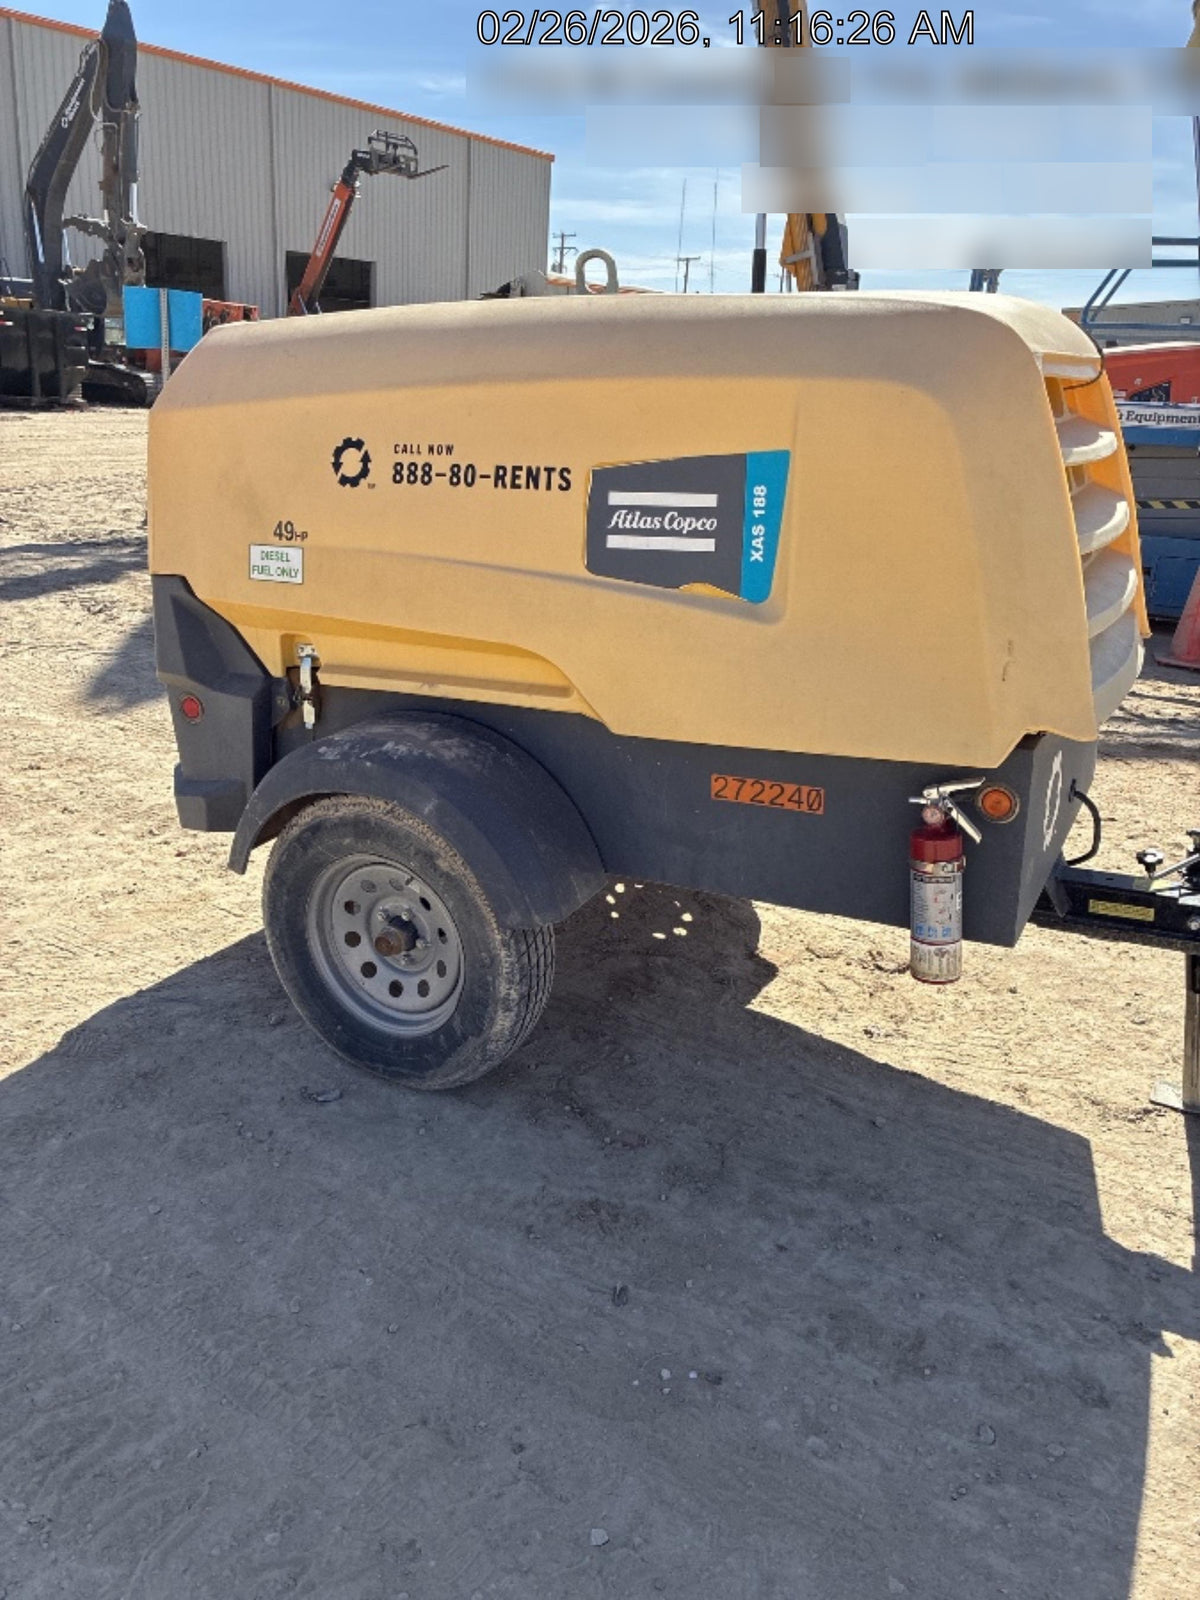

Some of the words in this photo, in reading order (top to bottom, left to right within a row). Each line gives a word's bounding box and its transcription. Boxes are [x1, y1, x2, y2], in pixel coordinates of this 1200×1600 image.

[394, 444, 421, 455] CALL
[428, 444, 454, 455] NOW
[392, 462, 572, 491] 888-80-RENTS
[752, 485, 768, 518] 188
[607, 510, 661, 529] Atlas
[663, 511, 718, 534] Copco
[260, 550, 291, 562] DIESEL
[750, 525, 766, 562] XAS
[252, 564, 274, 577] FUEL
[275, 566, 299, 578] ONLY
[713, 776, 822, 812] 272240
